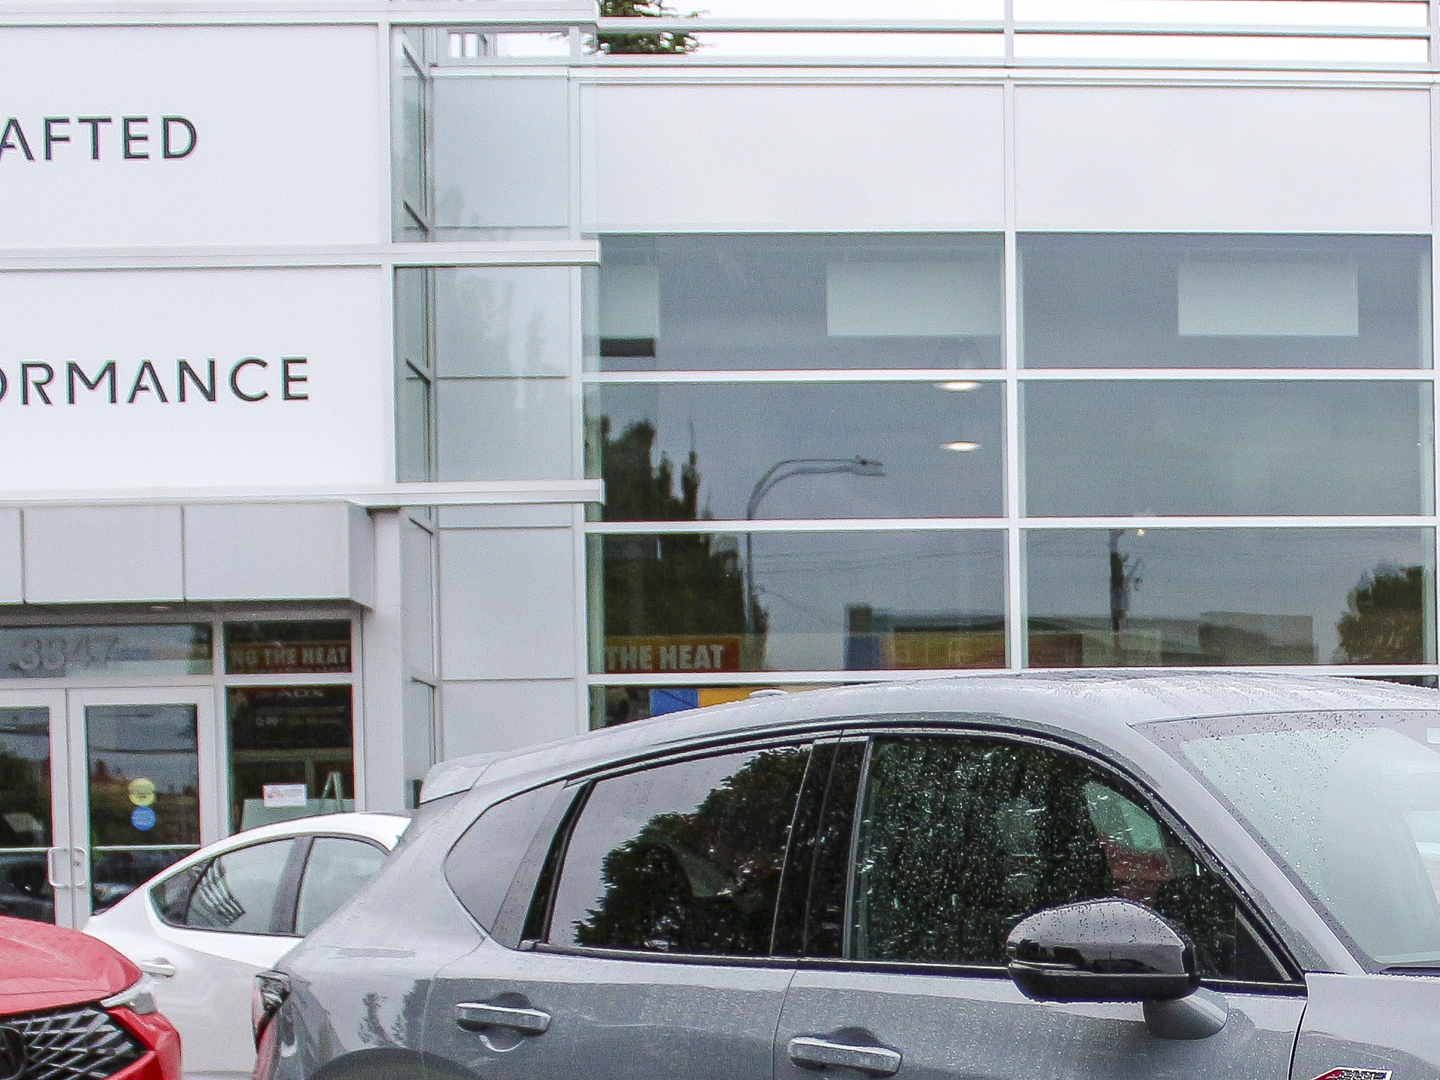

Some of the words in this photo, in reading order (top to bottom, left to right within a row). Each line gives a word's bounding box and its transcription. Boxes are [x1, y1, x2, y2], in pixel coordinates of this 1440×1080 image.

[0, 115, 197, 161] AFTED
[0, 358, 310, 406] RMANCE
[301, 646, 347, 664] HEAT
[606, 645, 653, 670] THE
[659, 644, 724, 670] HEAT
